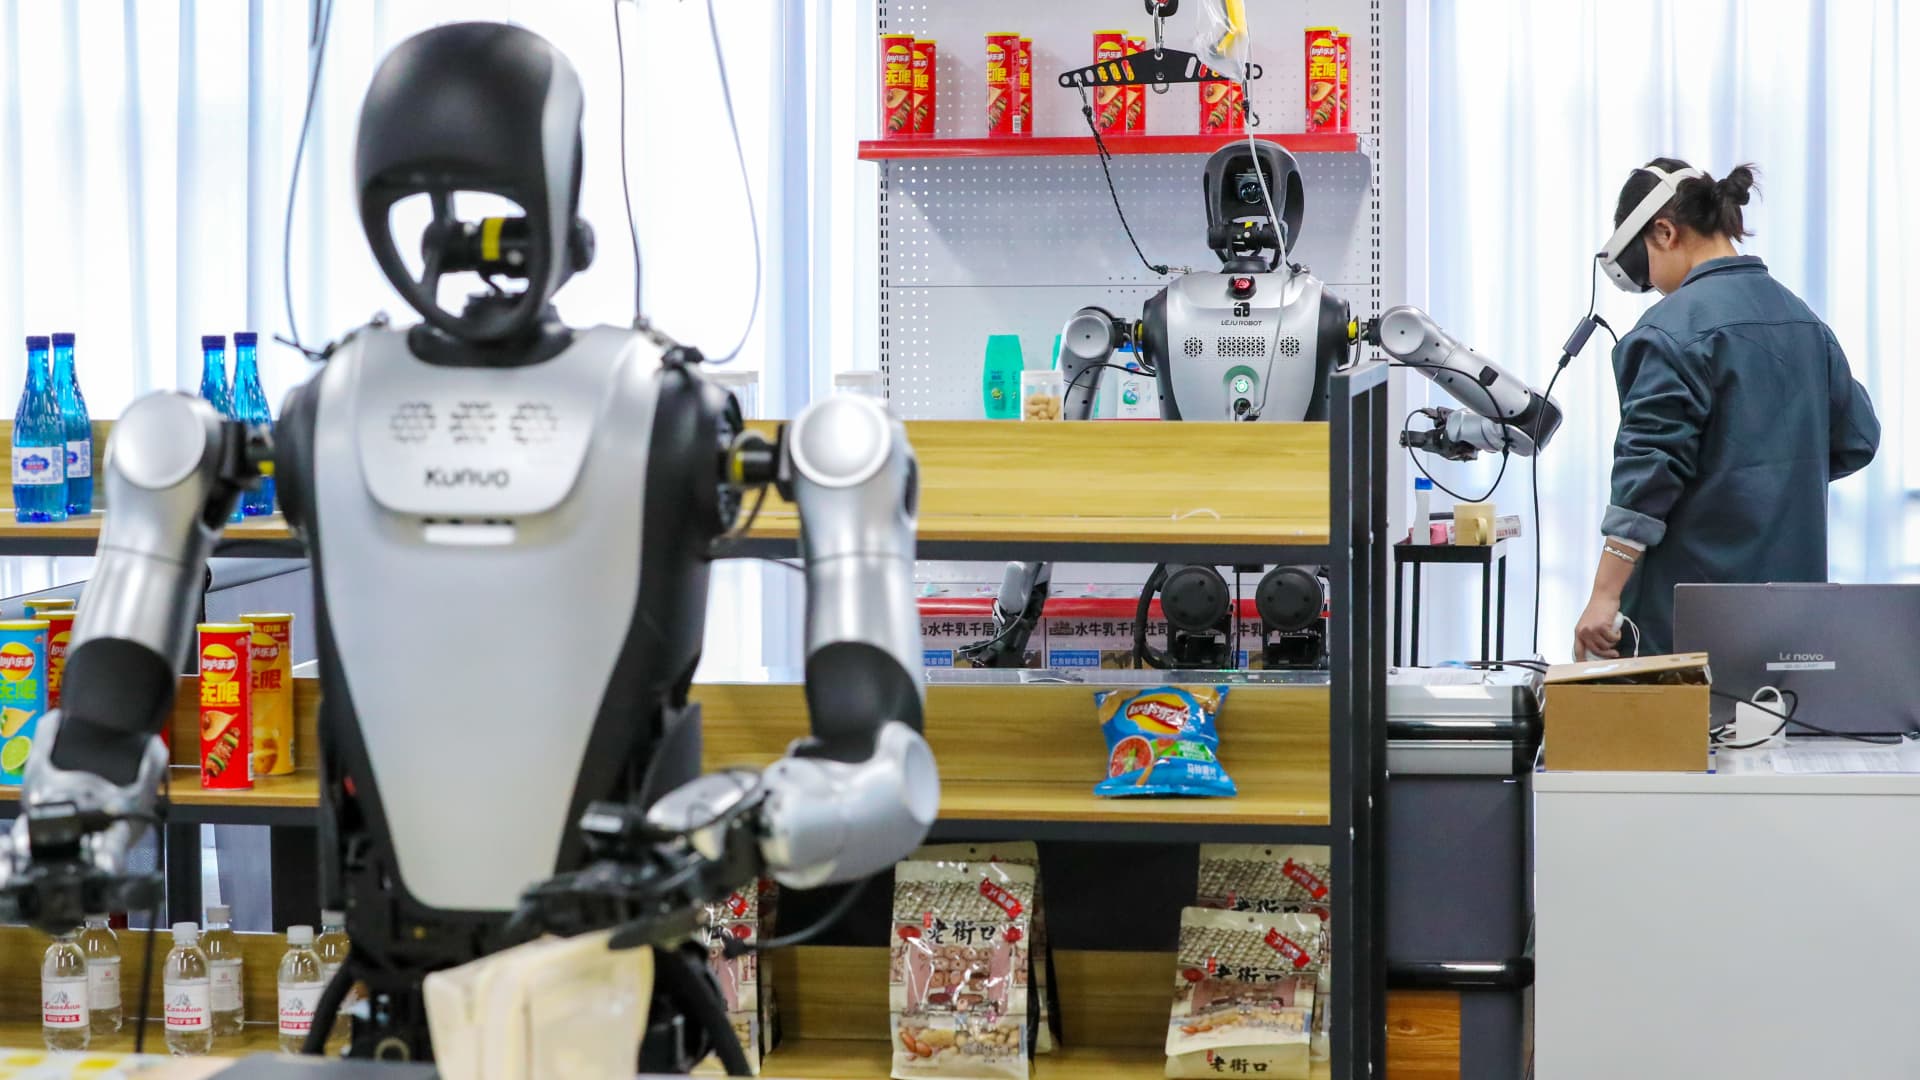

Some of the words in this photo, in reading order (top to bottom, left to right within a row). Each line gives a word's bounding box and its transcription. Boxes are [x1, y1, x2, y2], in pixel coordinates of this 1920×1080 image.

[928, 918, 996, 945] 老街口
[1210, 1056, 1268, 1074] 老街口
